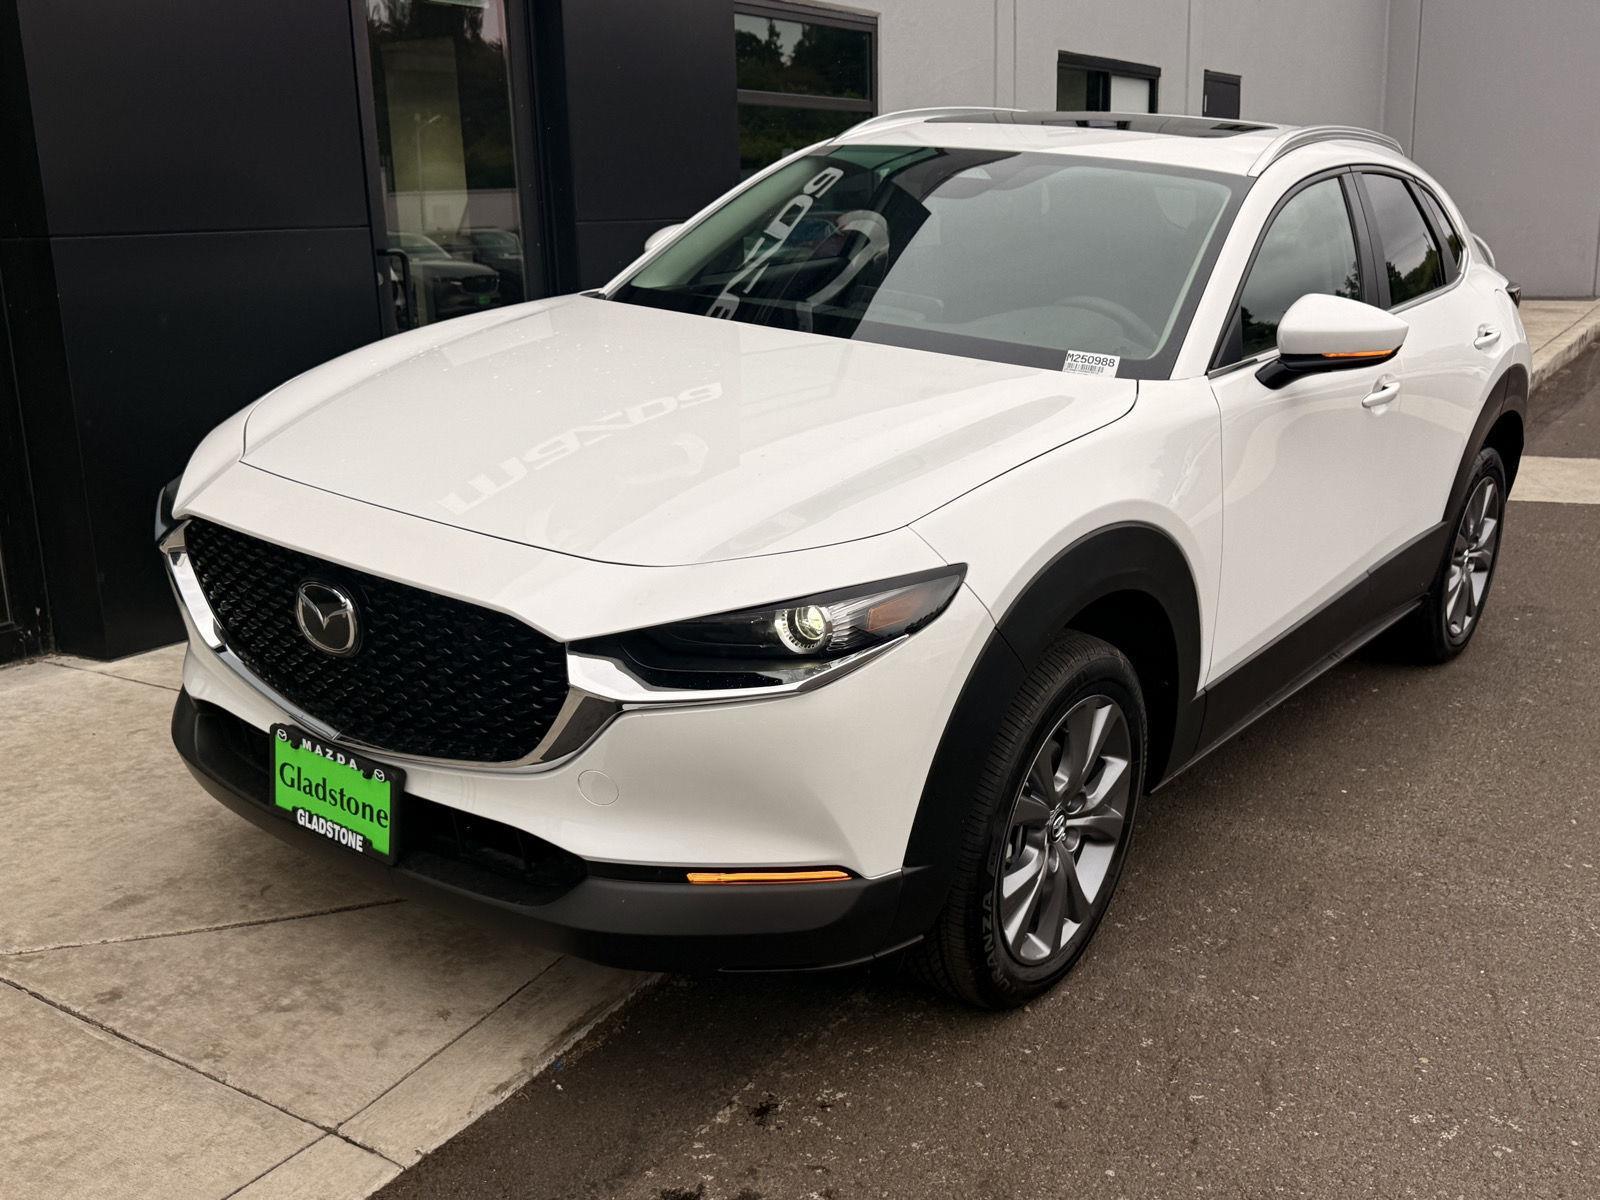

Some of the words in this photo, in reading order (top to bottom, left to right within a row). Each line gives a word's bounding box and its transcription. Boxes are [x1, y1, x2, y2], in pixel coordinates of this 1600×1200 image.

[1066, 352, 1116, 367] M250988
[302, 738, 358, 770] MAZDA
[279, 762, 389, 828] Gladstone
[297, 809, 364, 852] GLADSTONE
